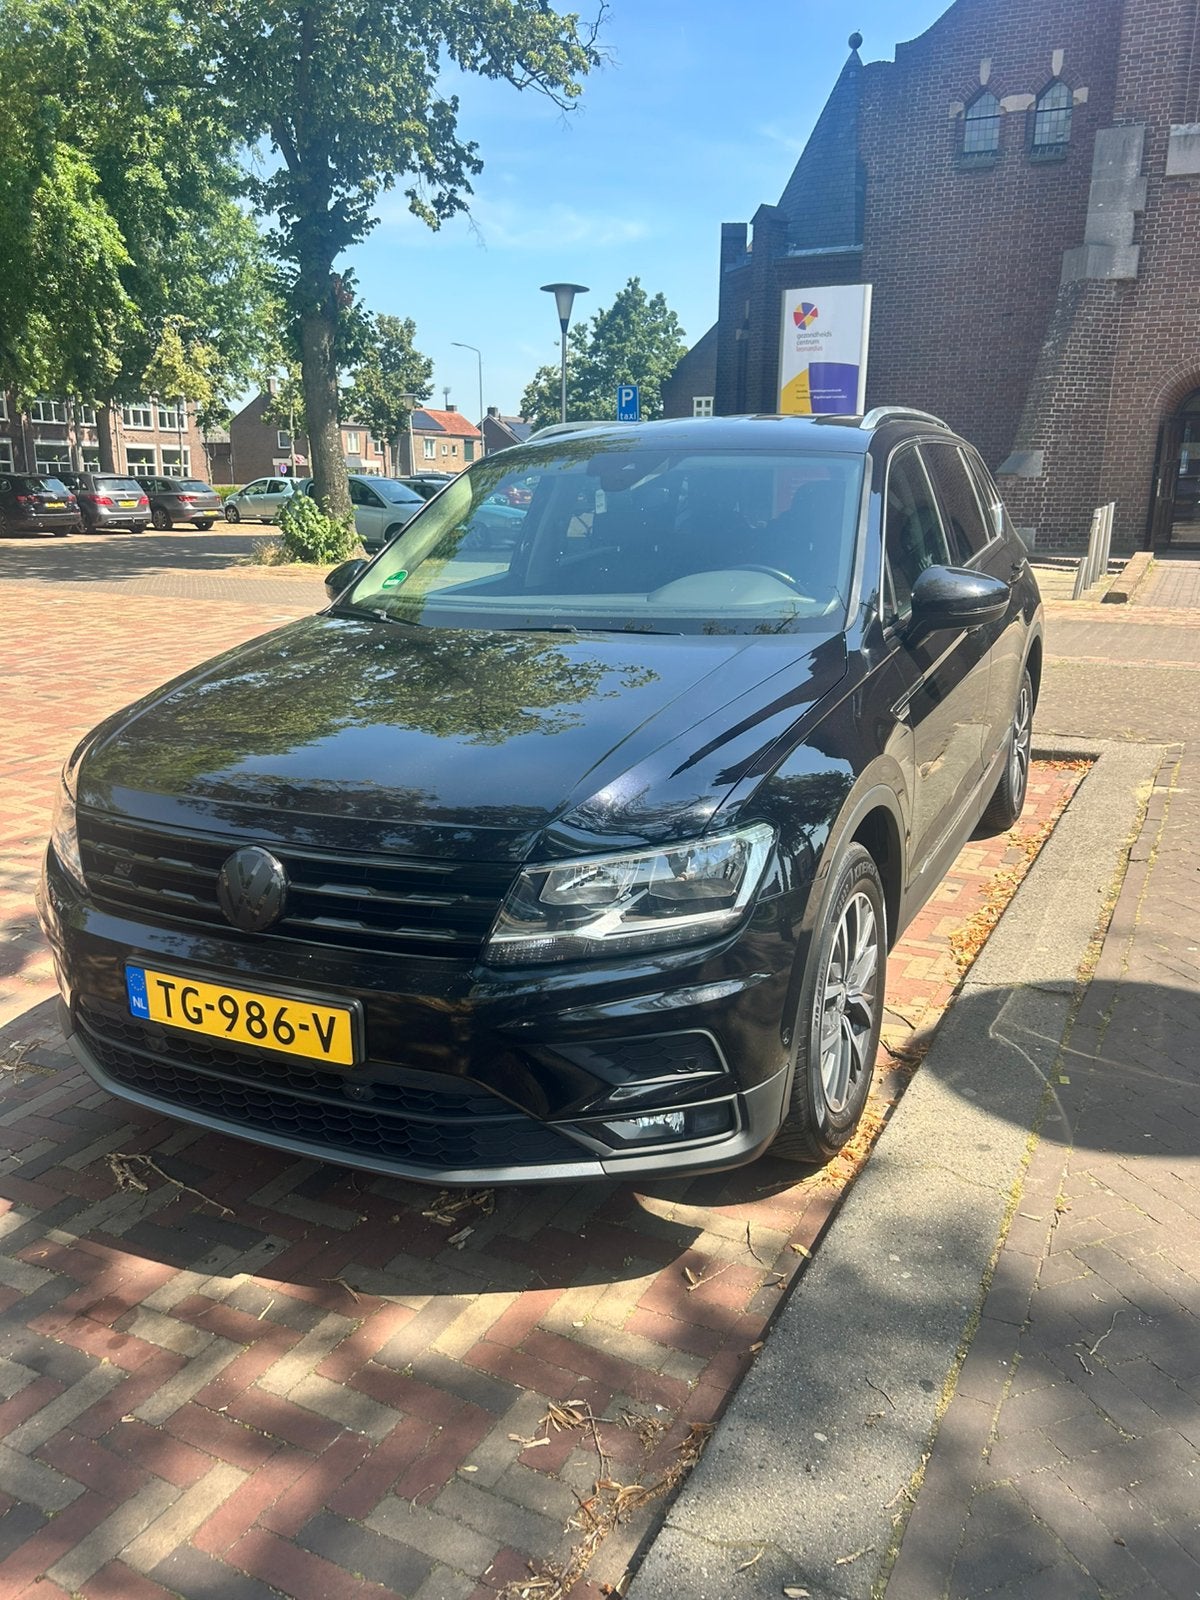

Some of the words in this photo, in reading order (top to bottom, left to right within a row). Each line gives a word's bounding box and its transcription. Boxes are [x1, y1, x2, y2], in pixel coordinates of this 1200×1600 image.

[796, 331, 832, 339] gezondheids
[622, 388, 634, 407] P
[620, 411, 636, 420] taxi
[132, 996, 147, 1010] NL
[156, 980, 336, 1053] TG-986-V
